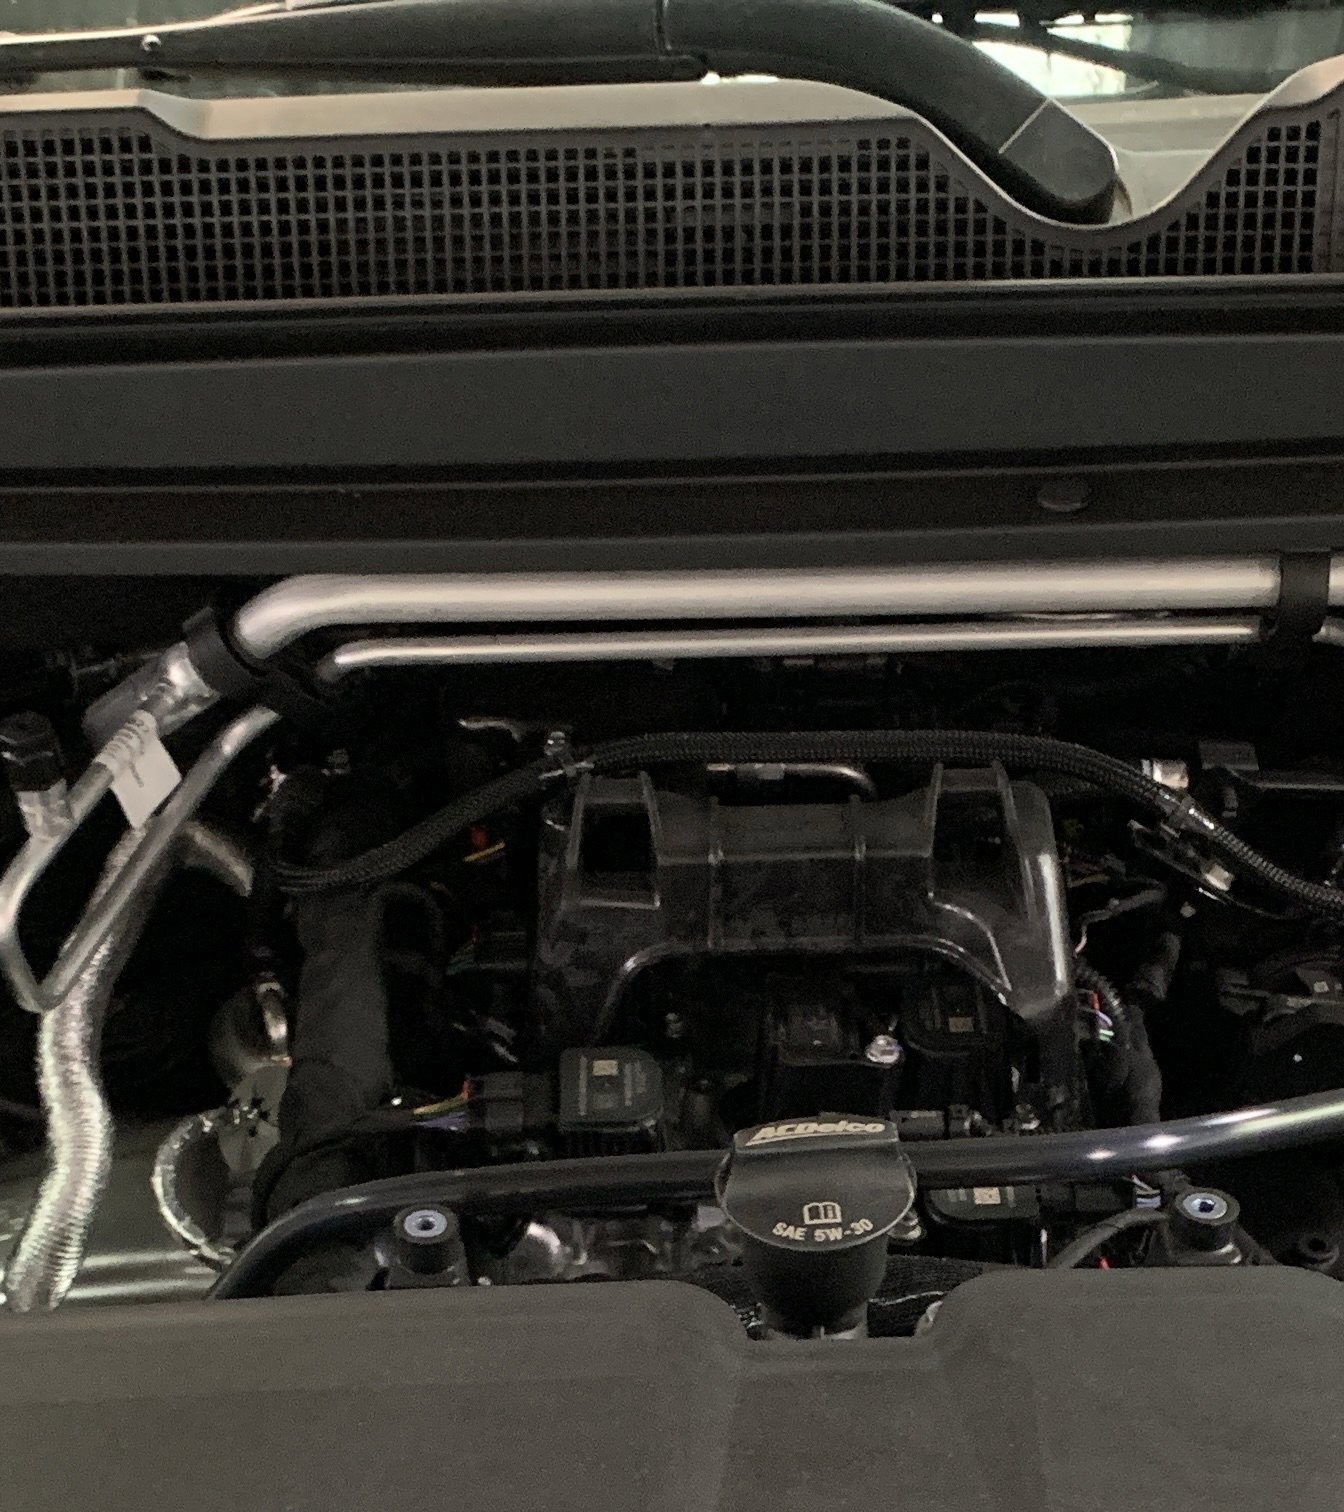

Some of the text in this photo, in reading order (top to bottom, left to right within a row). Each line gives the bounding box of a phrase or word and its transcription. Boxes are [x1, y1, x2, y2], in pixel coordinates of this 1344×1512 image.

[747, 1120, 886, 1145] ACDelco
[772, 1218, 874, 1242] SAE 5W-30
